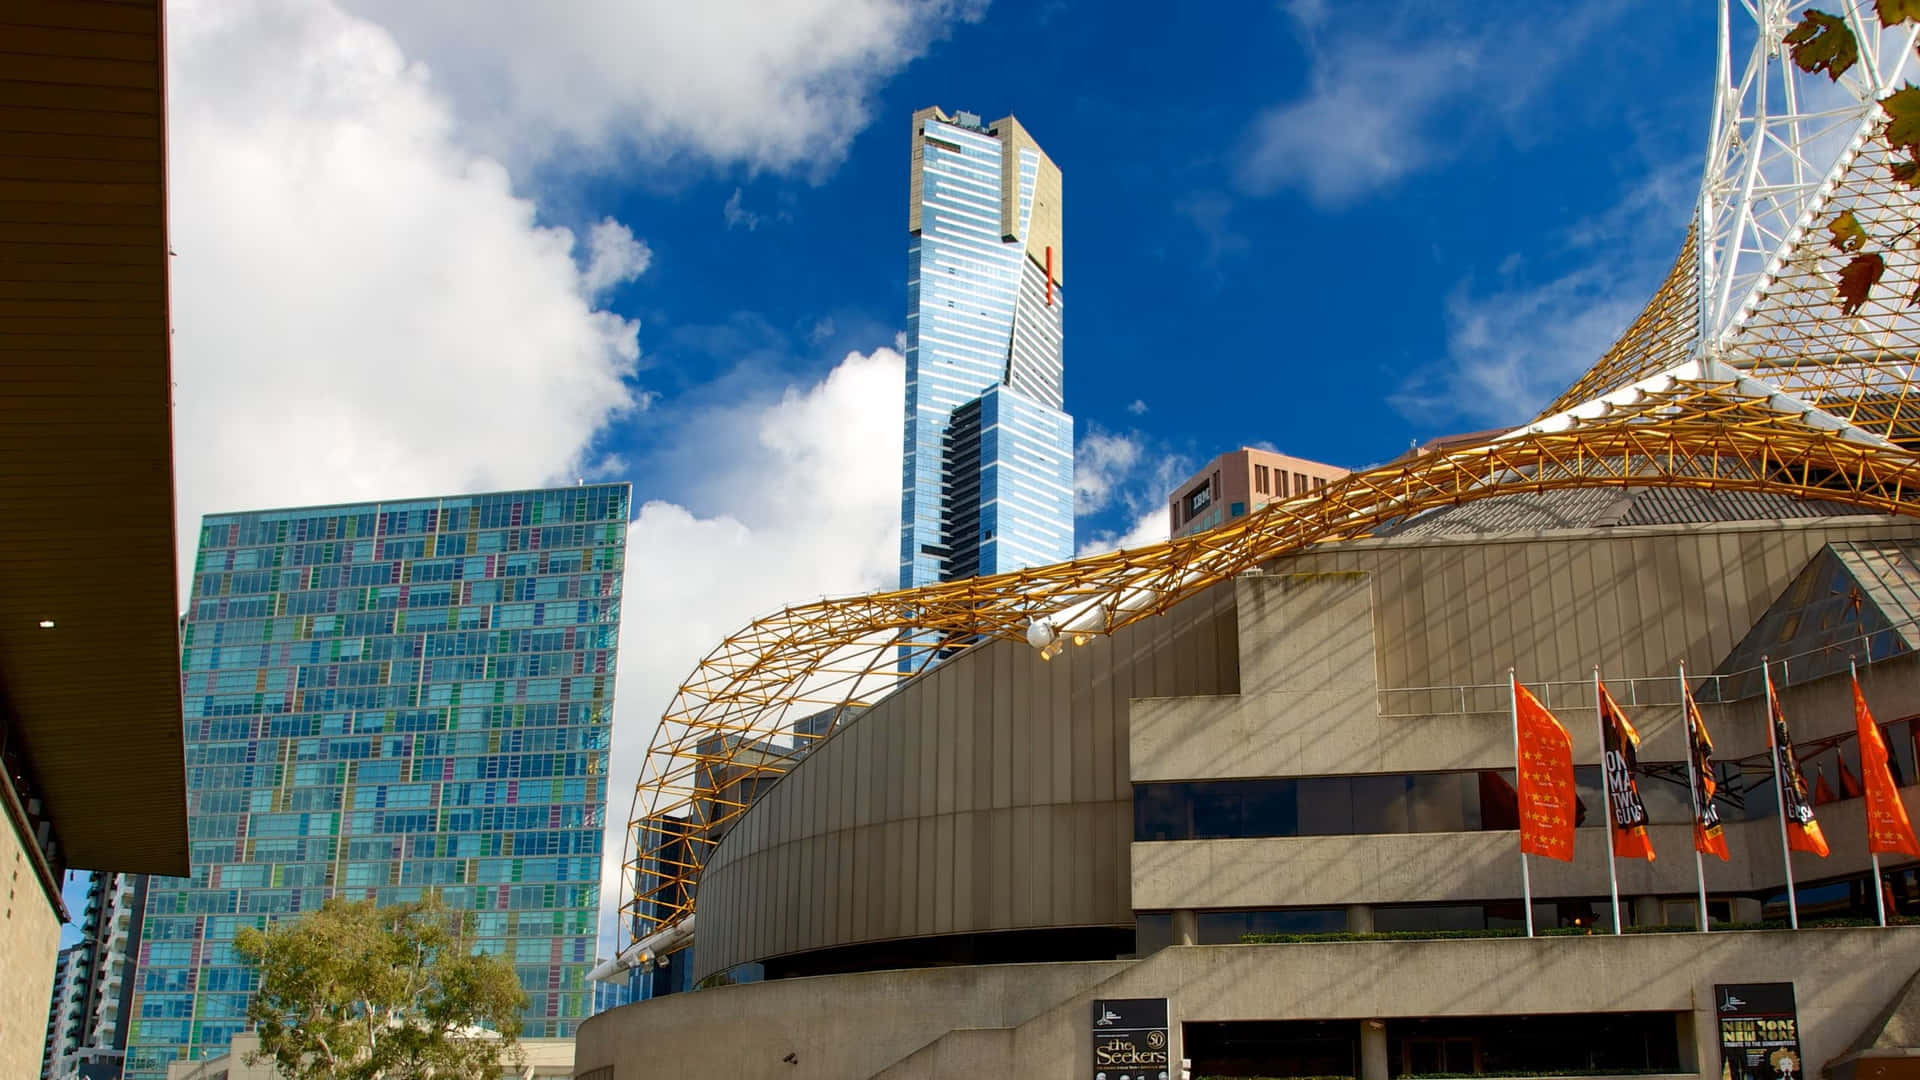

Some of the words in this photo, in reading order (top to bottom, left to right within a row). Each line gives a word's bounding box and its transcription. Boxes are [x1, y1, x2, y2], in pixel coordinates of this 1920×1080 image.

[1193, 487, 1210, 509] IBM
[1723, 1021, 1755, 1031] NEW
[1757, 1020, 1795, 1030] YORK
[1150, 1033, 1163, 1046] 50
[1723, 1031, 1756, 1042] NEW
[1759, 1030, 1796, 1041] YORK
[1108, 1038, 1132, 1051] the
[1096, 1045, 1167, 1065] Seekers
